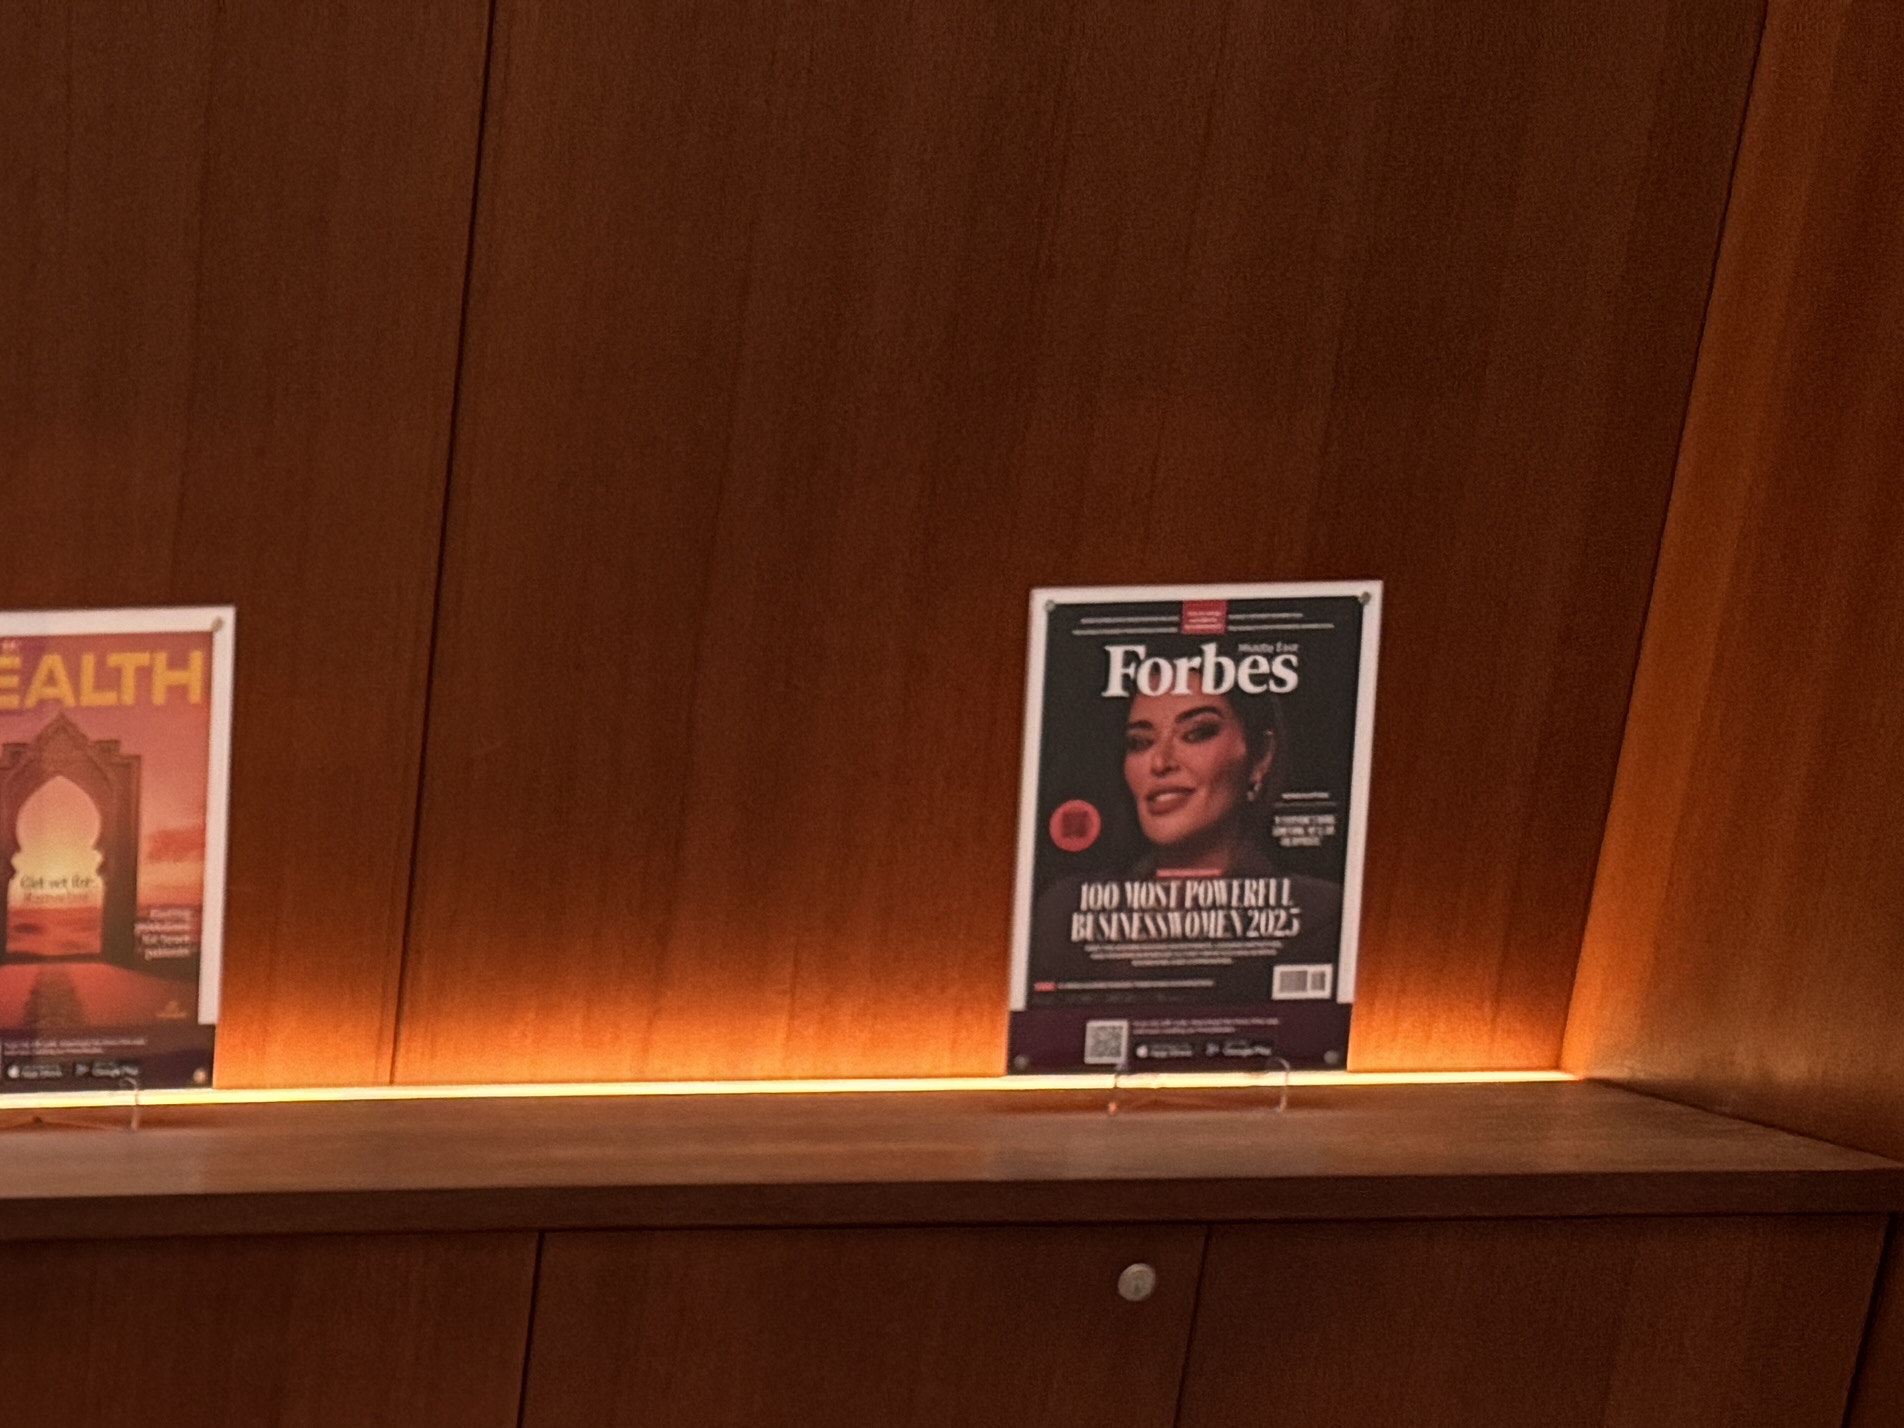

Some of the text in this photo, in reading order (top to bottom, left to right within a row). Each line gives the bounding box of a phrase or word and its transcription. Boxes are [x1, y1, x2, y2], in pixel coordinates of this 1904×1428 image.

[1102, 642, 1299, 697] Forbes
[1079, 877, 1293, 910] 100 MOST POWERFUL
[1071, 907, 1302, 943] BUSINESSWOMEN 2025
